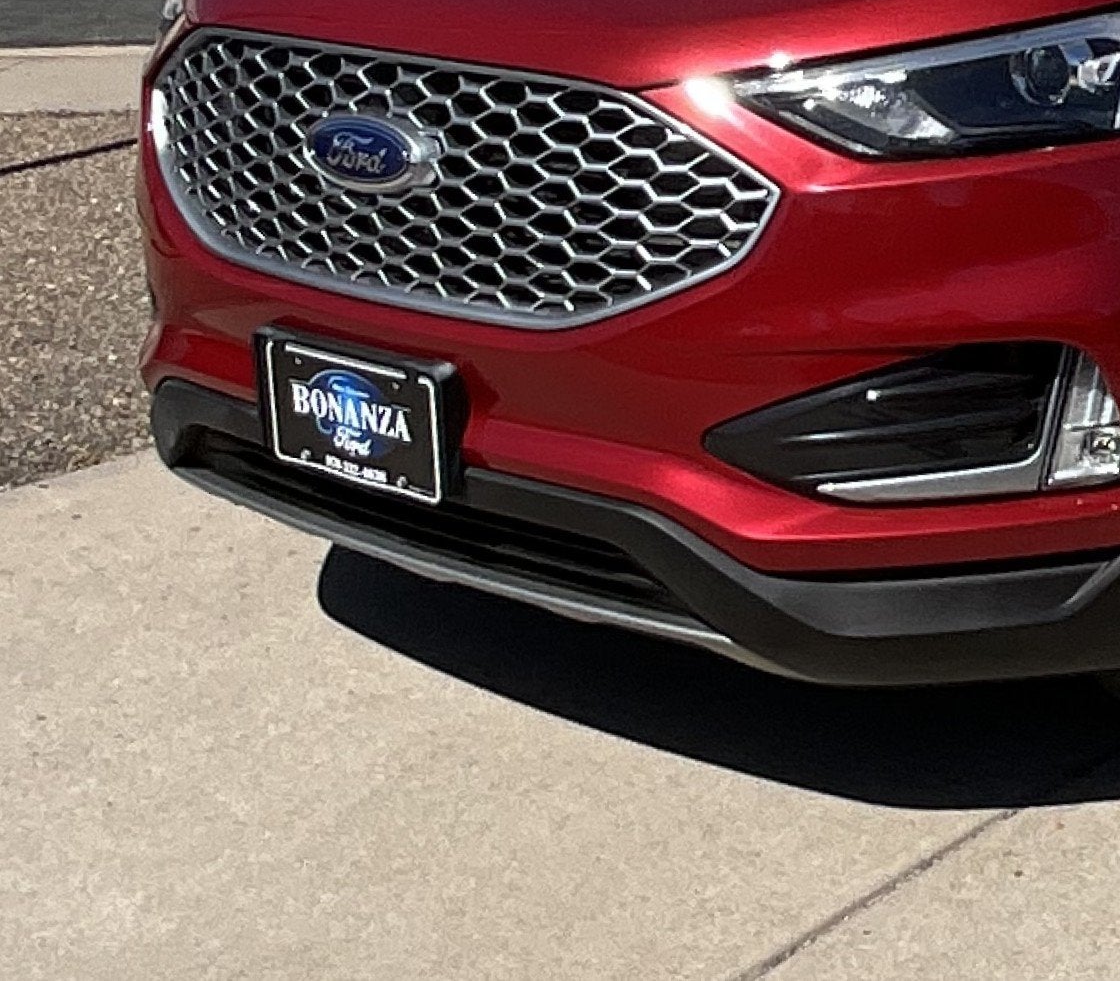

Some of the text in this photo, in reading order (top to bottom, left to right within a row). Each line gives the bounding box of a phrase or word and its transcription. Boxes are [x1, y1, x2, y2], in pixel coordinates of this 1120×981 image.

[327, 131, 388, 174] Ford
[289, 381, 412, 443] BONANZA
[333, 425, 372, 457] Ford
